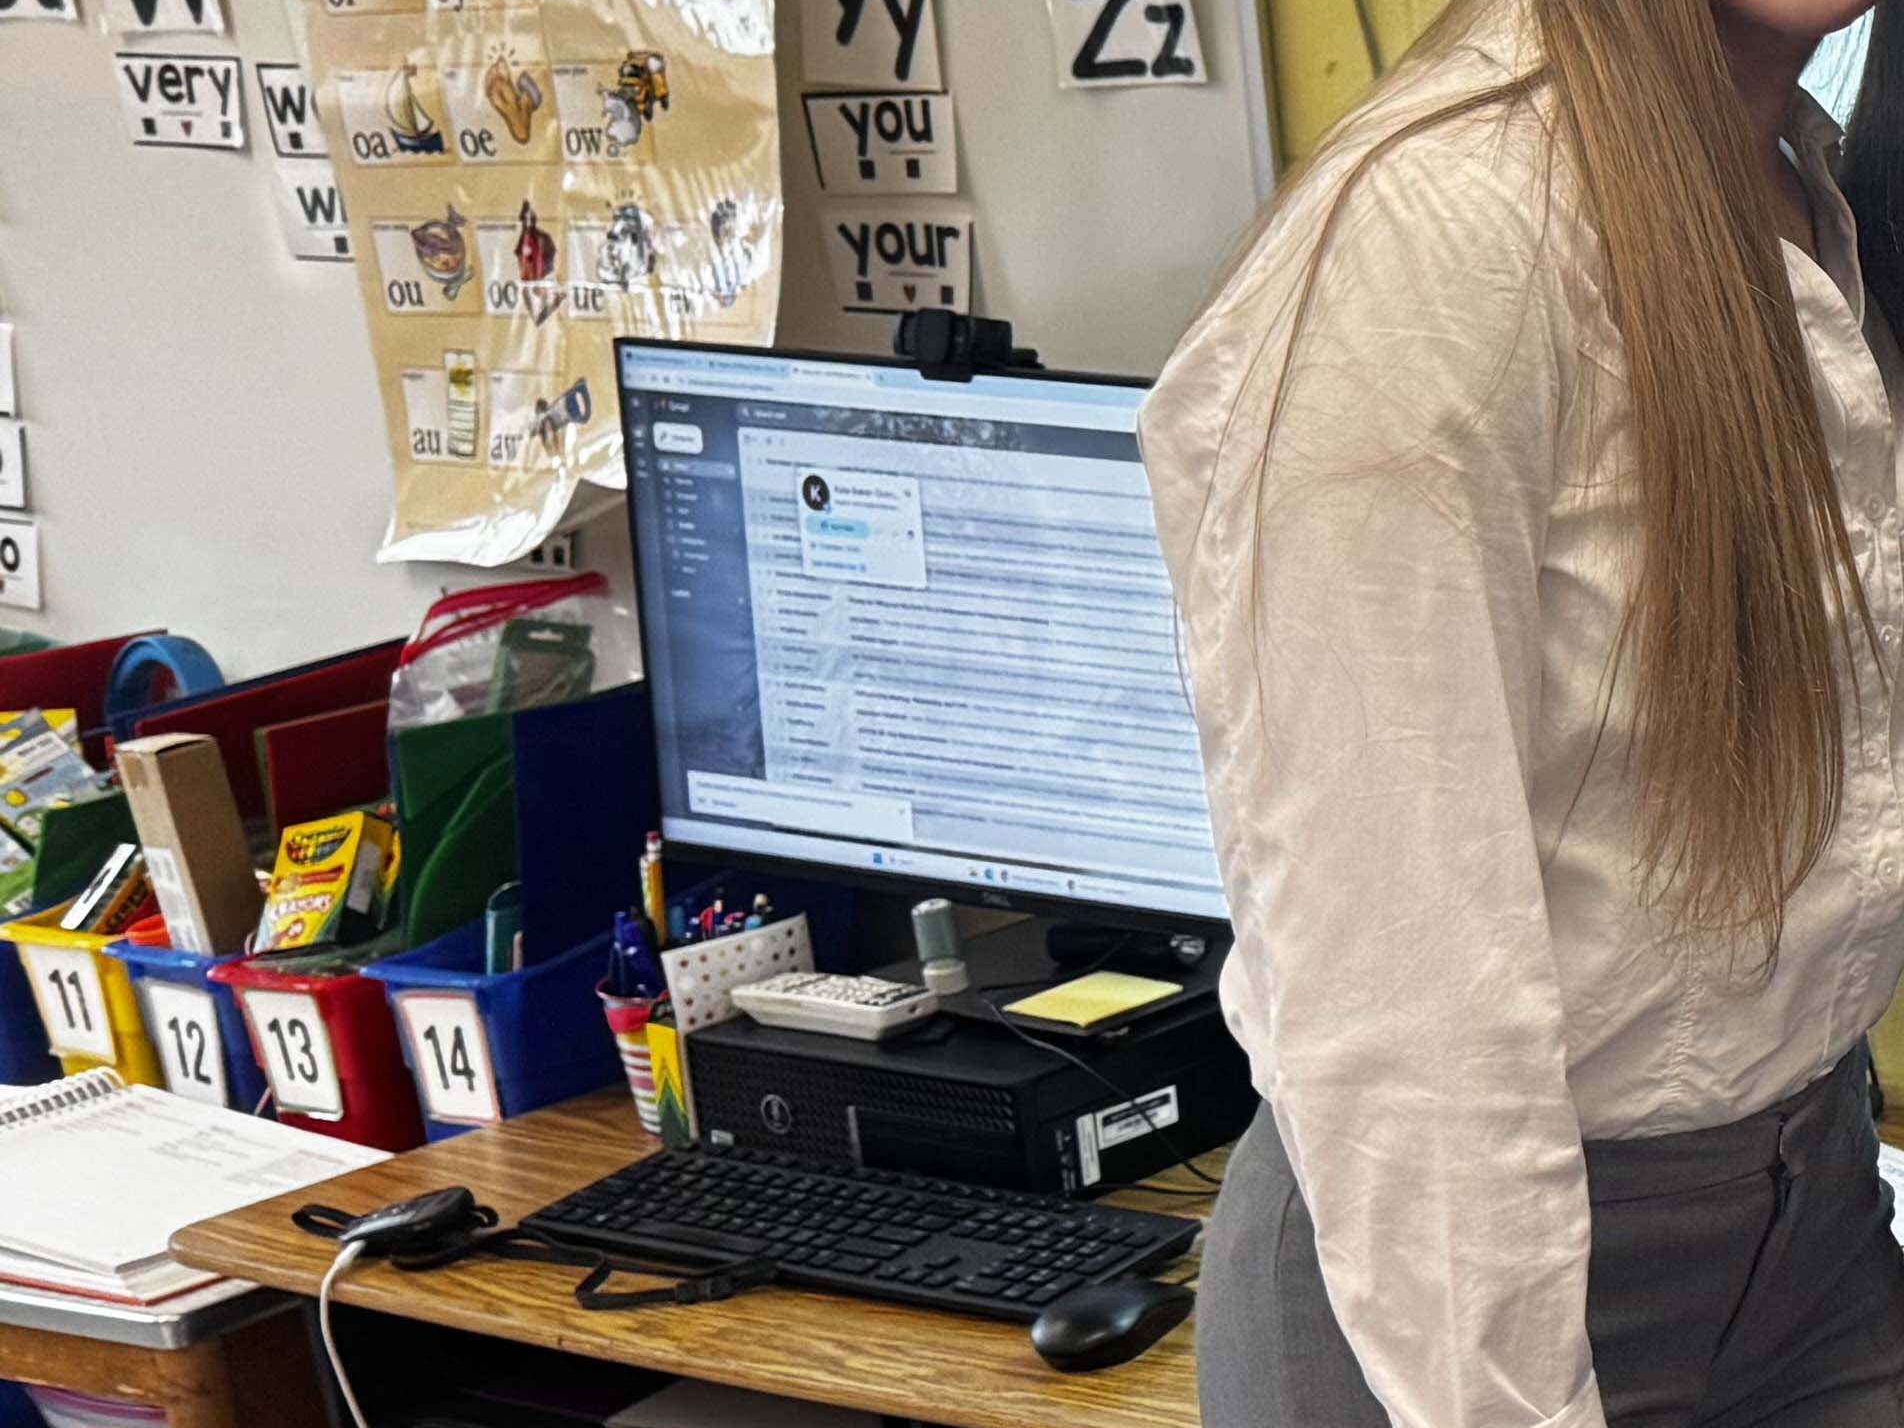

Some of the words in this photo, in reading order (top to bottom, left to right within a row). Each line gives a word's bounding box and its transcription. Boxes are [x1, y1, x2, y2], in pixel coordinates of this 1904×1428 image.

[123, 64, 231, 116] very
[352, 130, 387, 160] oa
[459, 126, 497, 158] oe
[565, 127, 604, 156] ow
[839, 98, 934, 157] you
[837, 222, 960, 278] your
[387, 277, 424, 309] ou
[412, 425, 442, 460] au
[48, 968, 94, 1032] 11
[168, 1016, 212, 1085] 12
[267, 1018, 319, 1084] 13
[423, 1025, 476, 1092] 14
